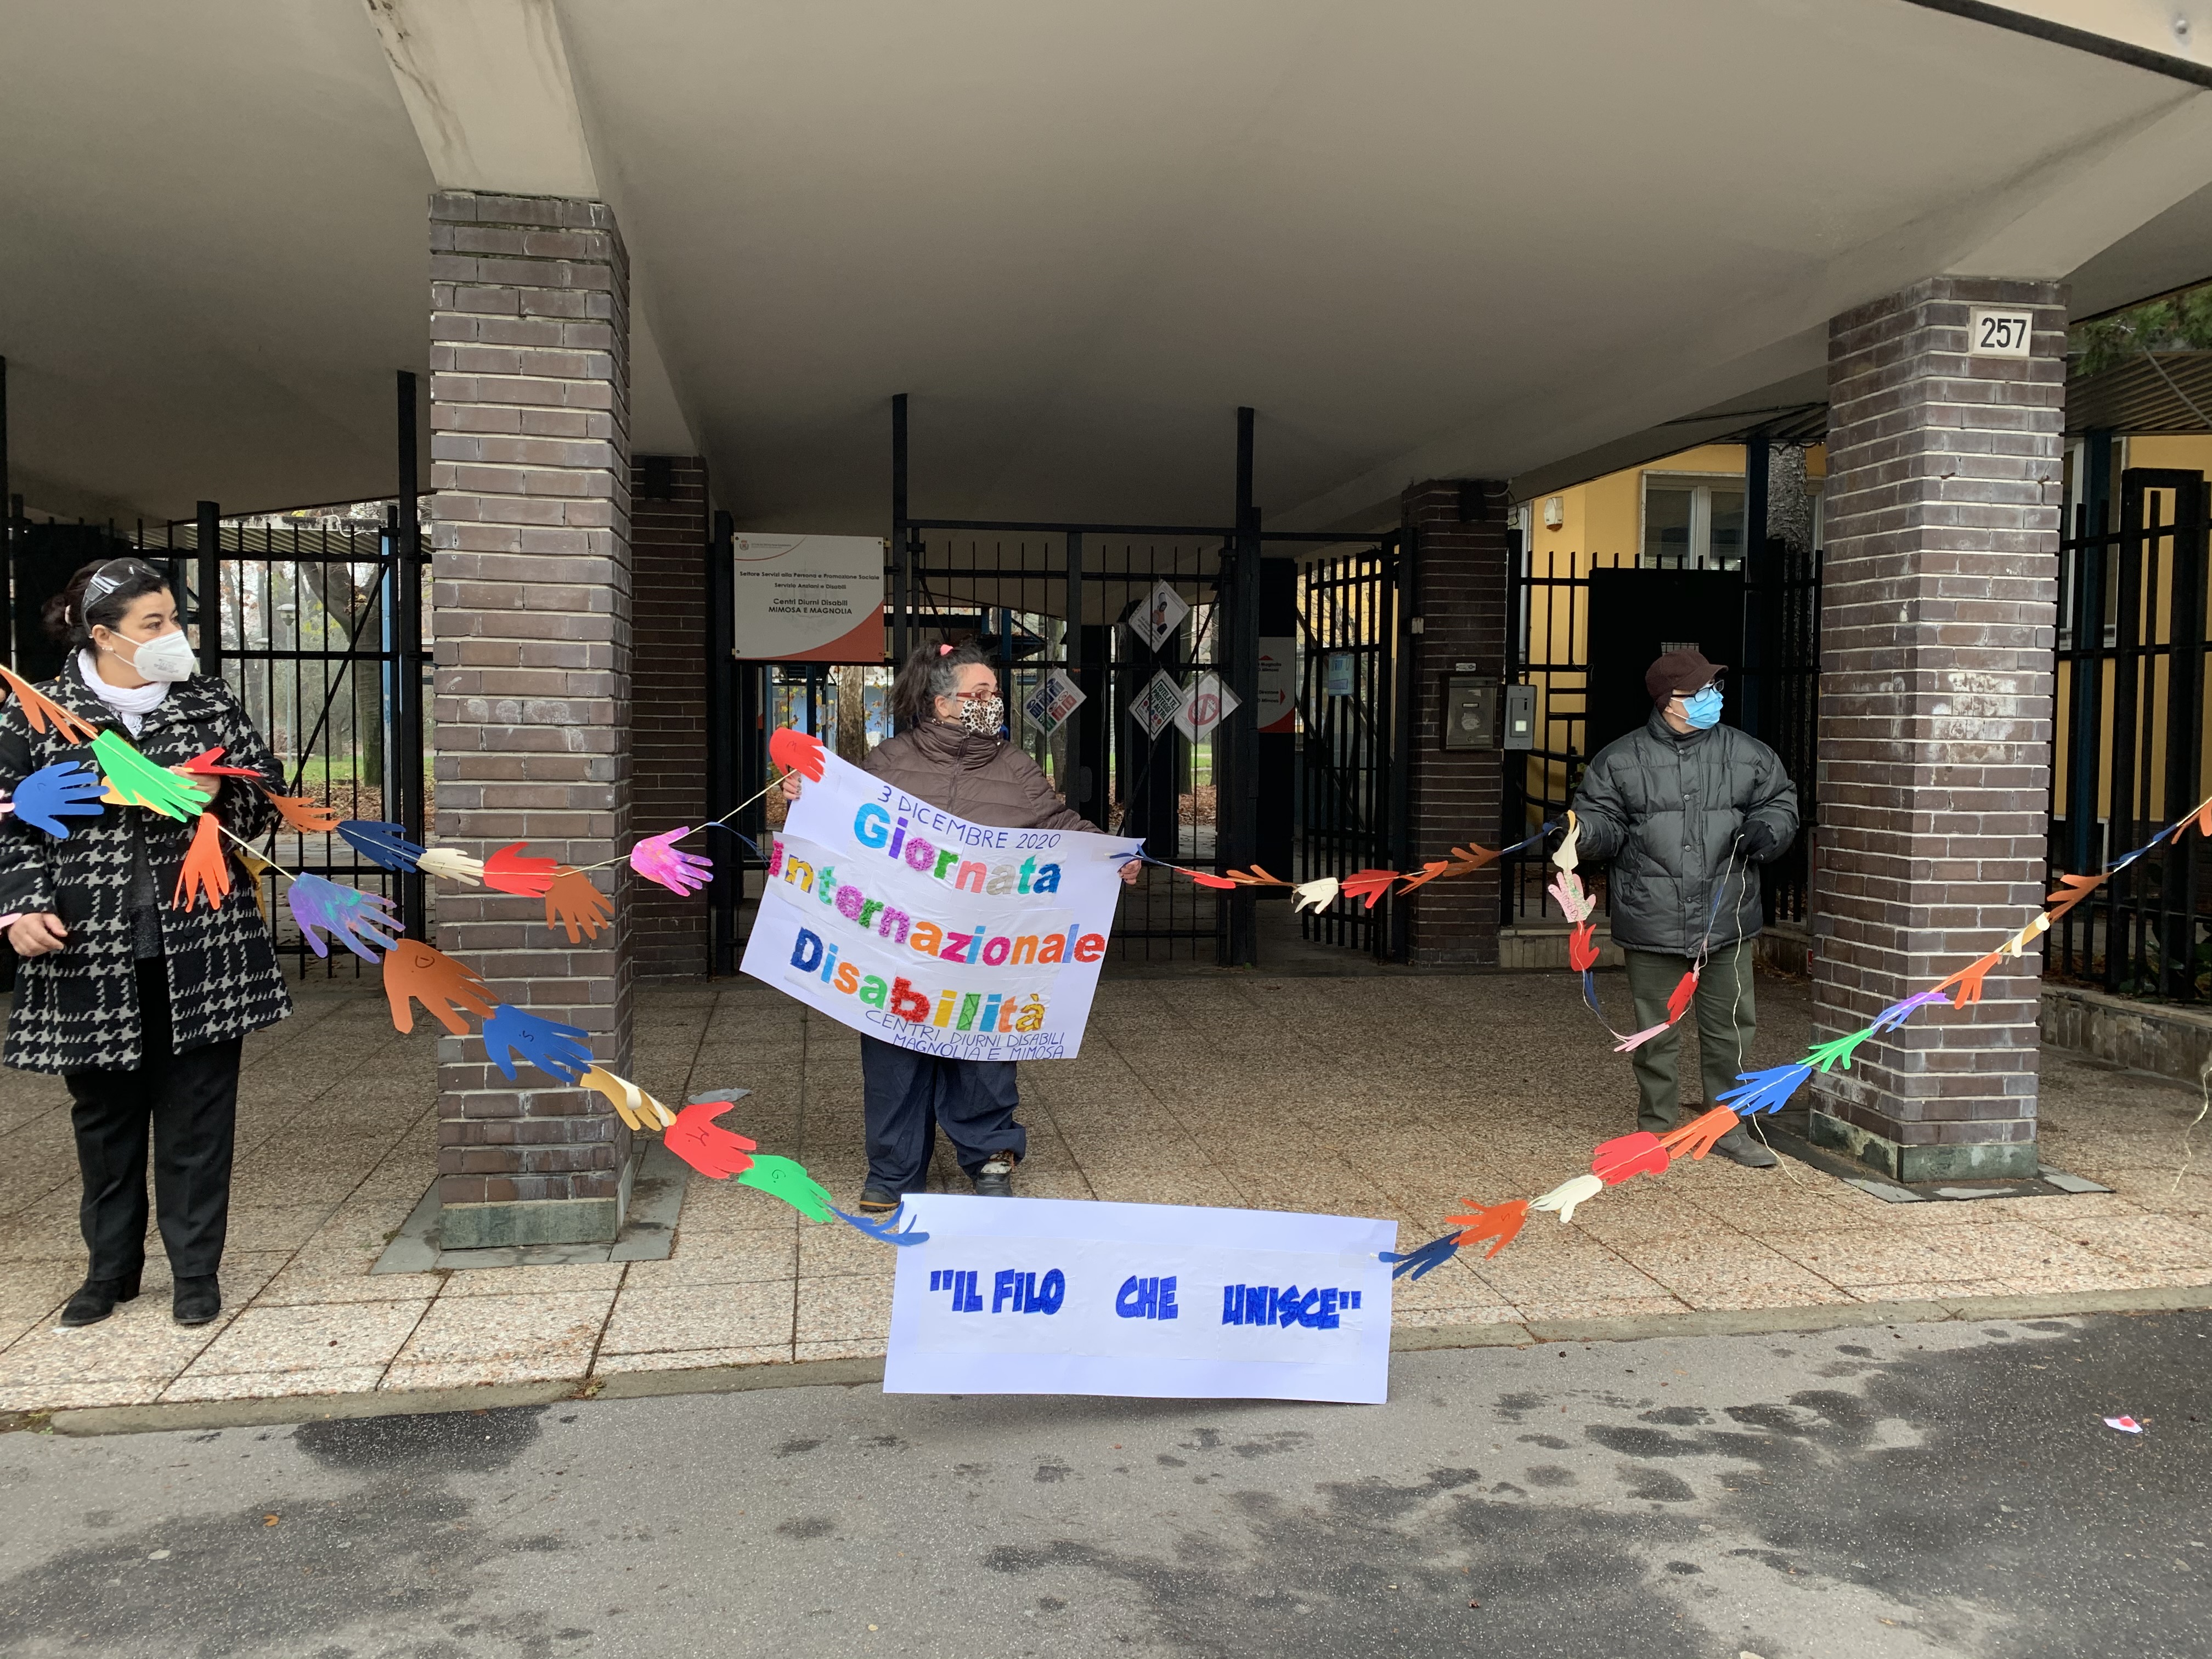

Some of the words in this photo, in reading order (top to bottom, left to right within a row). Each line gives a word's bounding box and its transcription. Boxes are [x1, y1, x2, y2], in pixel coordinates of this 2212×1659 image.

[1980, 317, 2027, 348] 257
[1152, 689, 1172, 713] PROTEGGI
[1157, 682, 1172, 703] TUTELA
[878, 786, 891, 803] 3
[898, 796, 1008, 849] DICEMBRE
[1015, 832, 1062, 850] 2020
[854, 803, 1062, 895] Giornata
[769, 840, 1106, 967] Internazionale
[789, 926, 1046, 1034] Disabilità
[865, 1010, 942, 1042] CENTRI
[950, 1031, 1002, 1047] DIURNI
[1007, 1032, 1064, 1047] DISABILI
[893, 1035, 981, 1060] MAGNOLIA
[988, 1047, 1001, 1060] E
[1010, 1045, 1064, 1060] MIMOSA
[992, 1268, 1066, 1315] FILO
[1115, 1274, 1178, 1321] CHE
[1222, 1284, 1363, 1330] UNISCE"
